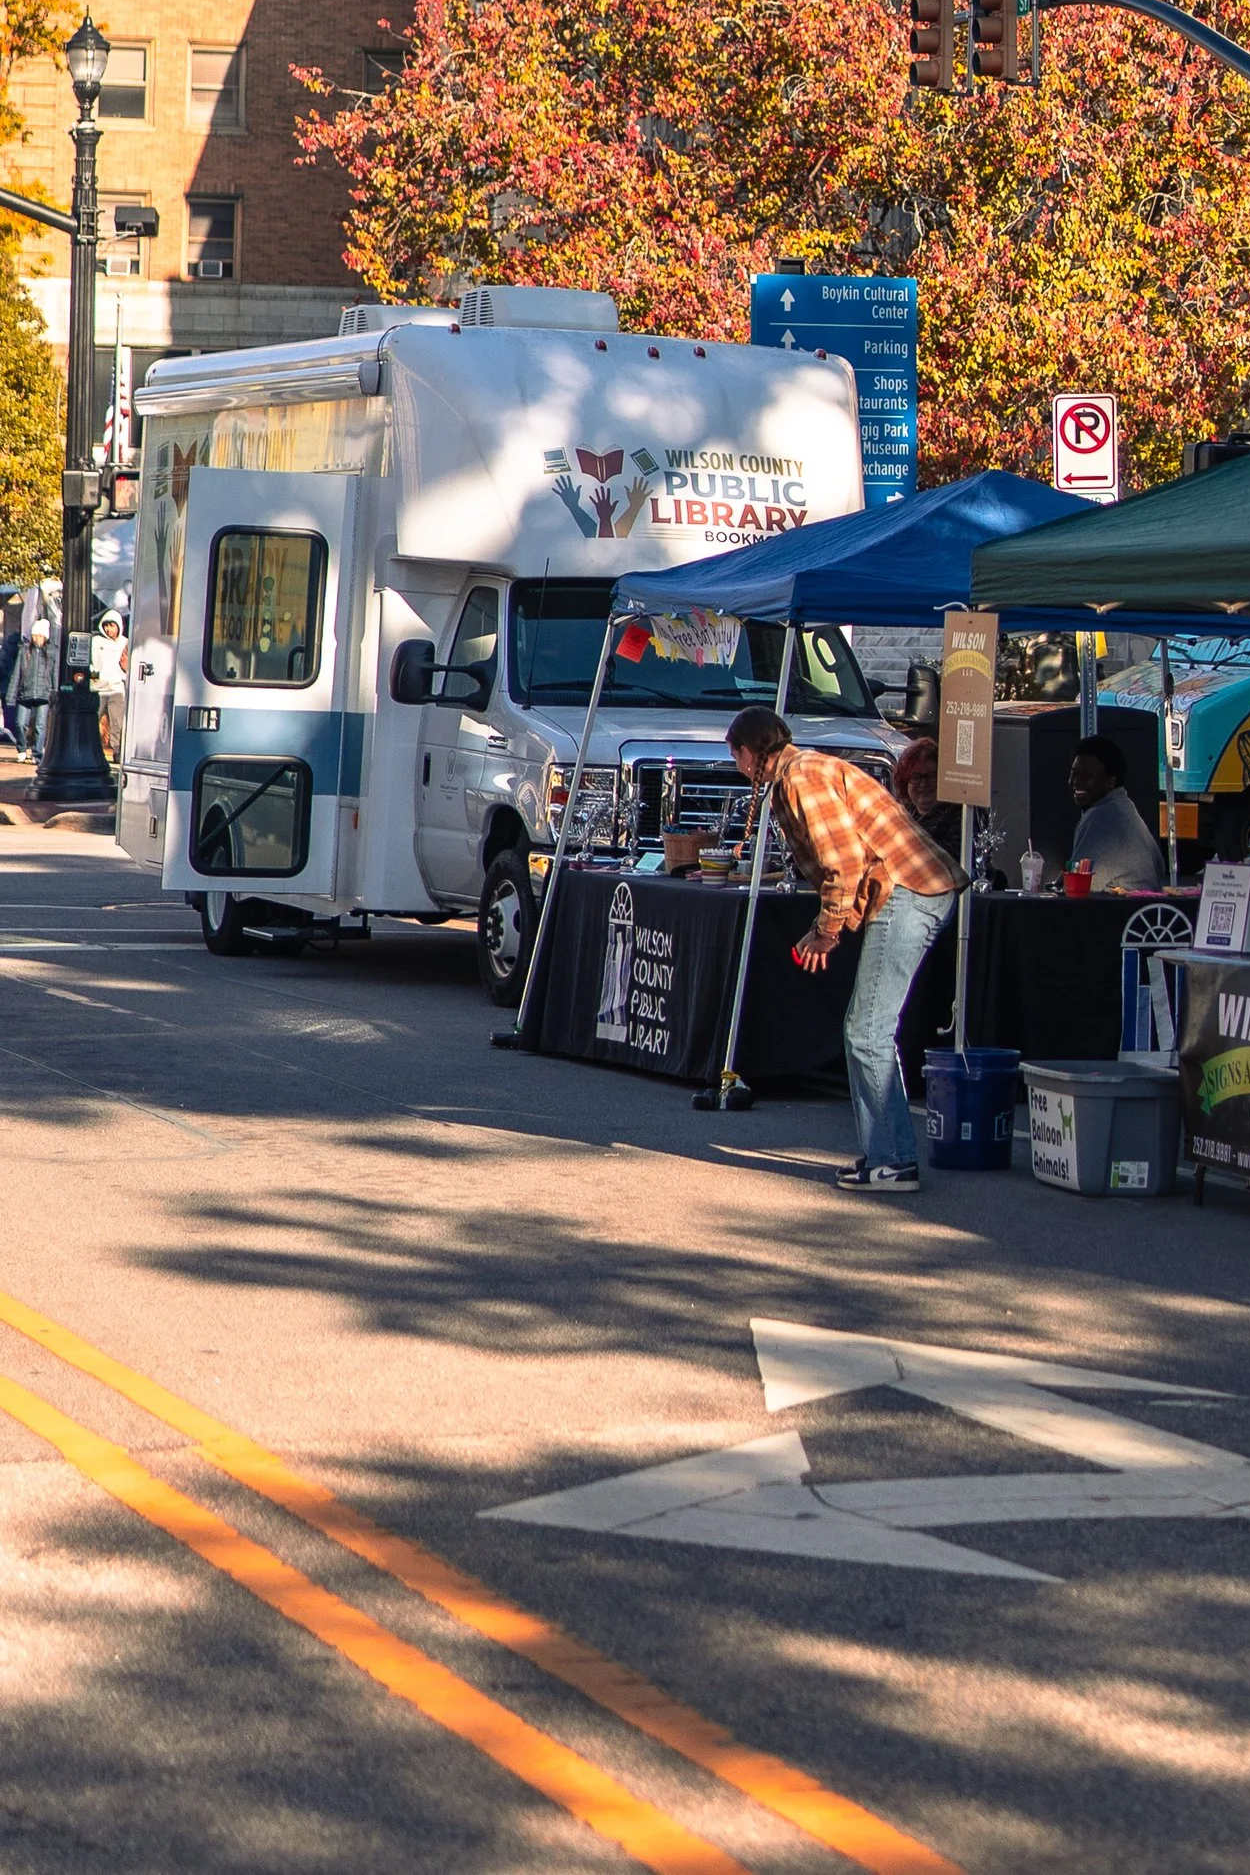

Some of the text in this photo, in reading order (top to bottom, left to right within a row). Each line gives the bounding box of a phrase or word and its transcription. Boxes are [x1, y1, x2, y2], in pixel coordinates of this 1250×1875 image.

[822, 286, 909, 303] Boykin Cultural
[872, 305, 909, 319] Center
[864, 341, 909, 358] Parking
[874, 376, 909, 393] Shops
[859, 396, 909, 410] taurants
[860, 422, 909, 440] gig Park
[863, 441, 909, 456] Museum
[665, 449, 803, 477] WILSON COUNTY
[862, 461, 909, 478] xchange
[664, 471, 807, 507] PUBLIC
[650, 498, 808, 532] LIBRARY
[705, 530, 775, 545] BOOKM
[668, 624, 696, 647] Free
[951, 631, 986, 651] WILSON
[962, 668, 973, 677] LLC
[635, 925, 673, 958] WILSON
[633, 958, 674, 991] COUNTY
[1207, 1060, 1242, 1094] SIGNS
[1030, 1086, 1048, 1113] Free
[1031, 1118, 1062, 1147] Balloon
[1192, 1135, 1232, 1163] 252.218.9881
[1033, 1149, 1070, 1181] Animals!
